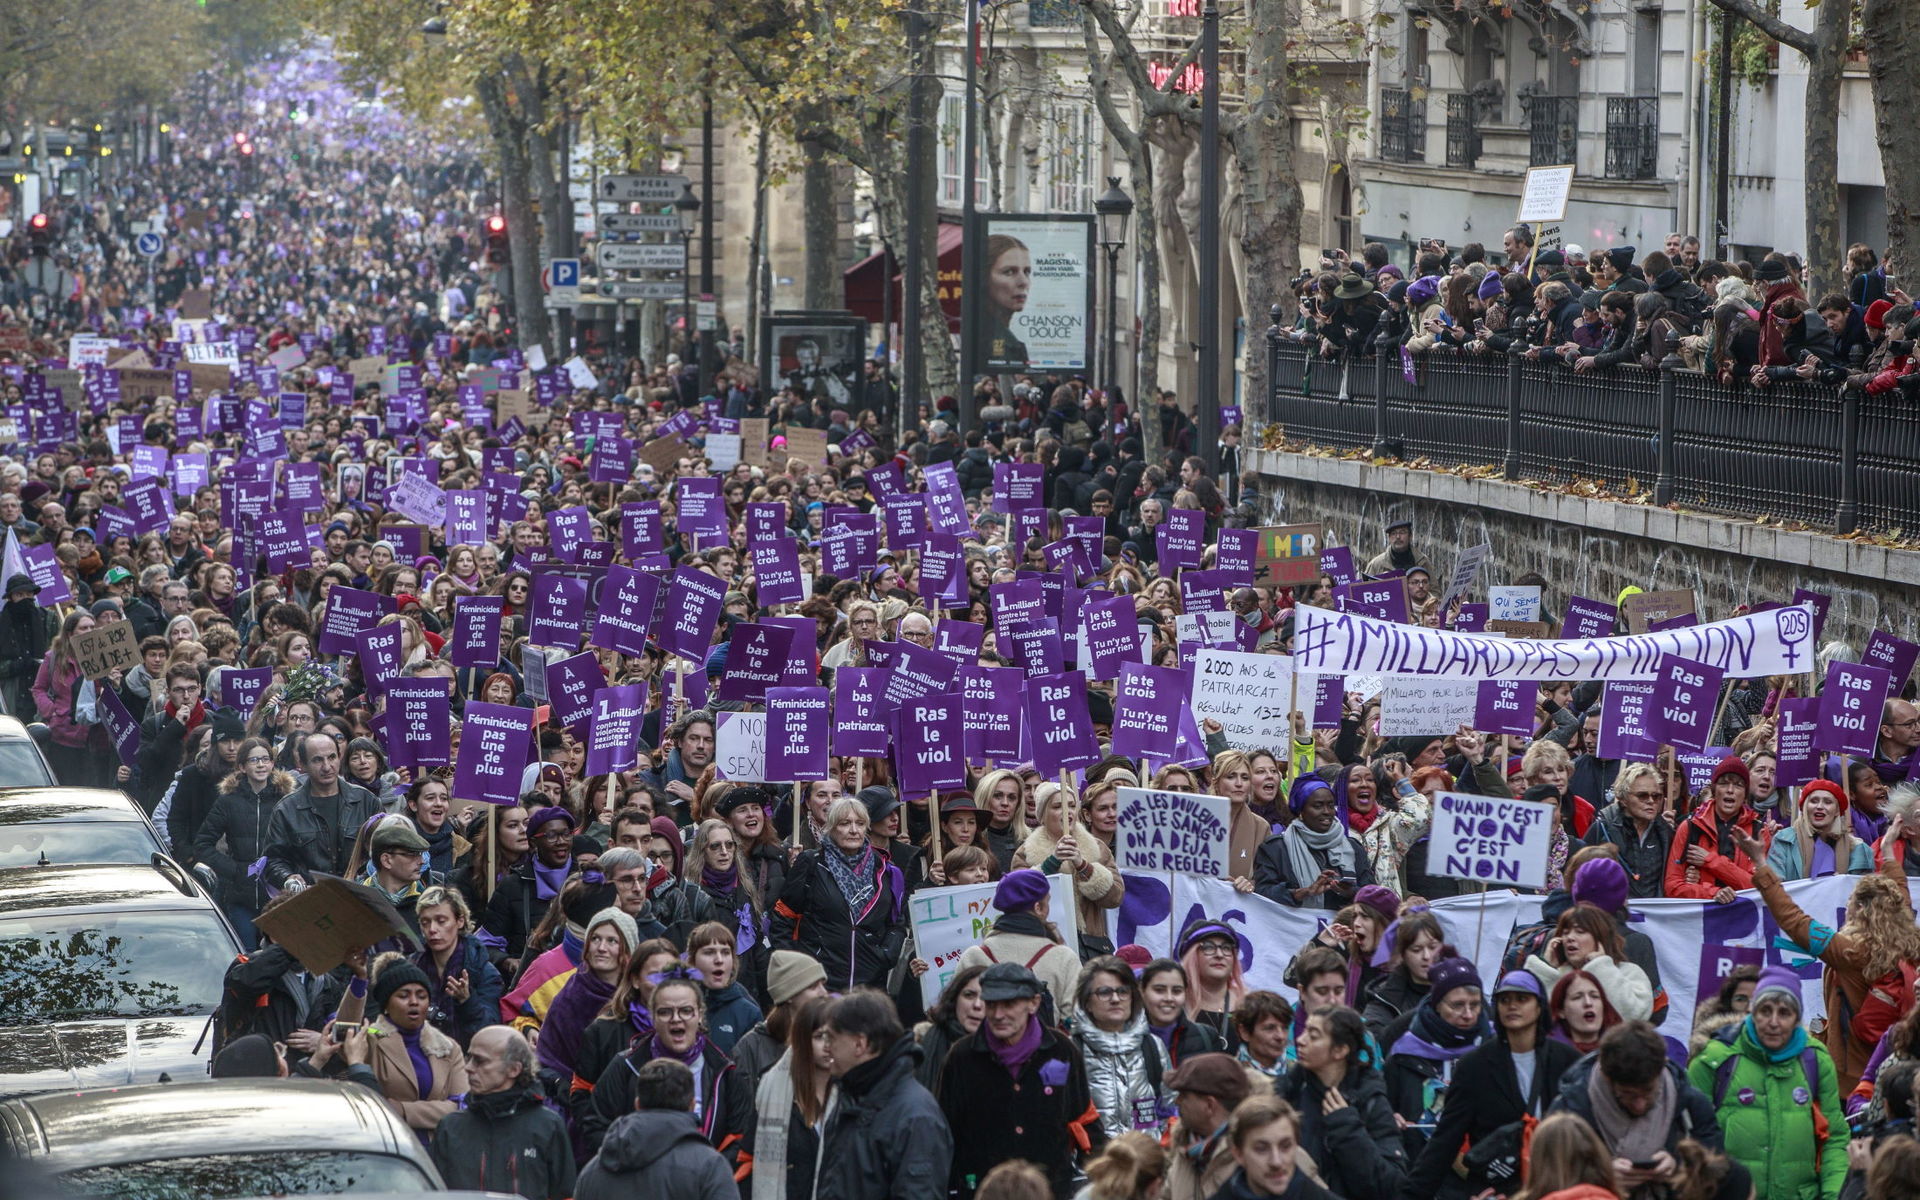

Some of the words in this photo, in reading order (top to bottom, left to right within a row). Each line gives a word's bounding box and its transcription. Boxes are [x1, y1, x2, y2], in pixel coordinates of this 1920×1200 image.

[627, 190, 675, 198] CONCORDE
[559, 265, 572, 283] P
[1019, 315, 1082, 326] CHANSON
[1029, 327, 1071, 338] DOUCE
[872, 470, 892, 482] Ras
[125, 483, 156, 498] Féminicides
[135, 492, 149, 500] pas
[239, 488, 248, 502] 1
[455, 495, 476, 506] Ras
[102, 511, 135, 526] Féminicides
[141, 509, 156, 519] plus
[459, 509, 471, 519] le
[624, 508, 658, 517] Féminicides
[754, 509, 775, 517] Ras
[555, 514, 578, 526] Ras
[940, 516, 960, 528] viol
[1022, 515, 1040, 524] Ras
[265, 527, 287, 536] crois
[455, 522, 477, 531] viol
[1052, 545, 1073, 559] Ras
[1222, 543, 1241, 551] crois
[269, 549, 287, 558] pour
[583, 549, 603, 560] Ras
[757, 556, 780, 565] crois
[1269, 561, 1316, 582] TUER
[676, 575, 722, 599] Féminicides
[618, 589, 639, 603] bas
[1364, 592, 1390, 603] Ras
[1009, 599, 1040, 609] milliard
[1495, 598, 1510, 607] QUI
[1513, 608, 1531, 616] VENT
[1571, 605, 1614, 622] Féminicides
[1644, 611, 1667, 619] SALOPE
[535, 618, 579, 630] patriarcat
[600, 614, 645, 635] patriarcat
[675, 621, 699, 636] plus
[1091, 619, 1116, 630] crois
[1012, 628, 1056, 640] Féminicides
[1579, 625, 1596, 636] une
[368, 635, 394, 650] Ras
[1024, 639, 1042, 650] pas
[1873, 639, 1884, 649] Je
[746, 644, 769, 656] bas
[1870, 648, 1894, 663] crois
[378, 651, 392, 665] le
[726, 669, 779, 682] patriarcat
[895, 652, 909, 676] 1
[909, 674, 946, 690] milliard
[1239, 667, 1257, 677] ANS
[1263, 664, 1276, 679] de
[1671, 666, 1704, 687] Ras
[233, 677, 260, 689] Ras
[563, 681, 586, 694] bas
[1839, 672, 1871, 691] Ras
[389, 689, 445, 698] Féminicides
[889, 681, 924, 697] violences
[965, 689, 995, 700] crois
[1041, 685, 1071, 702] Ras
[1125, 687, 1156, 699] crois
[1201, 680, 1279, 699] PATRIARCAT
[1500, 689, 1515, 699] de
[240, 693, 254, 705] le
[853, 692, 872, 702] bas
[1674, 686, 1691, 705] le
[1843, 691, 1860, 709] le
[406, 701, 426, 710] pas
[771, 700, 826, 708] Féminicides
[1198, 702, 1243, 715] Résultat
[1494, 699, 1518, 711] plus
[1620, 705, 1643, 715] une
[406, 712, 428, 720] une
[611, 705, 642, 718] milliard
[786, 712, 807, 721] pas
[915, 707, 948, 722] Ras
[1050, 705, 1066, 721] le
[1663, 706, 1697, 727] viol
[468, 714, 527, 731] Féminicides
[838, 722, 885, 732] patriarcat
[1120, 719, 1145, 732] pour
[1147, 721, 1168, 733] rien
[1832, 714, 1865, 731] viol
[483, 729, 506, 741] pas
[924, 726, 940, 743] le
[1045, 723, 1076, 743] viol
[1617, 724, 1643, 737] plus
[406, 731, 431, 743] plus
[481, 741, 505, 752] une
[784, 744, 809, 755] plus
[917, 746, 951, 764] viol
[475, 763, 504, 776] plus
[1441, 796, 1493, 817] QUAND
[1498, 804, 1543, 826] C'EST
[1118, 800, 1146, 827] POUR
[1146, 794, 1169, 810] LES
[1172, 795, 1227, 842] DOULEURS
[1133, 816, 1147, 830] ET
[1152, 811, 1167, 827] LE
[1171, 811, 1210, 841] SANG
[1453, 817, 1526, 845] NON
[1127, 831, 1146, 848] ON
[1151, 828, 1165, 849] A
[1456, 838, 1510, 857] C'EST
[1126, 851, 1156, 868] NOS
[1163, 852, 1221, 876] REGLES
[1446, 855, 1520, 882] NON
[914, 896, 958, 924] Il
